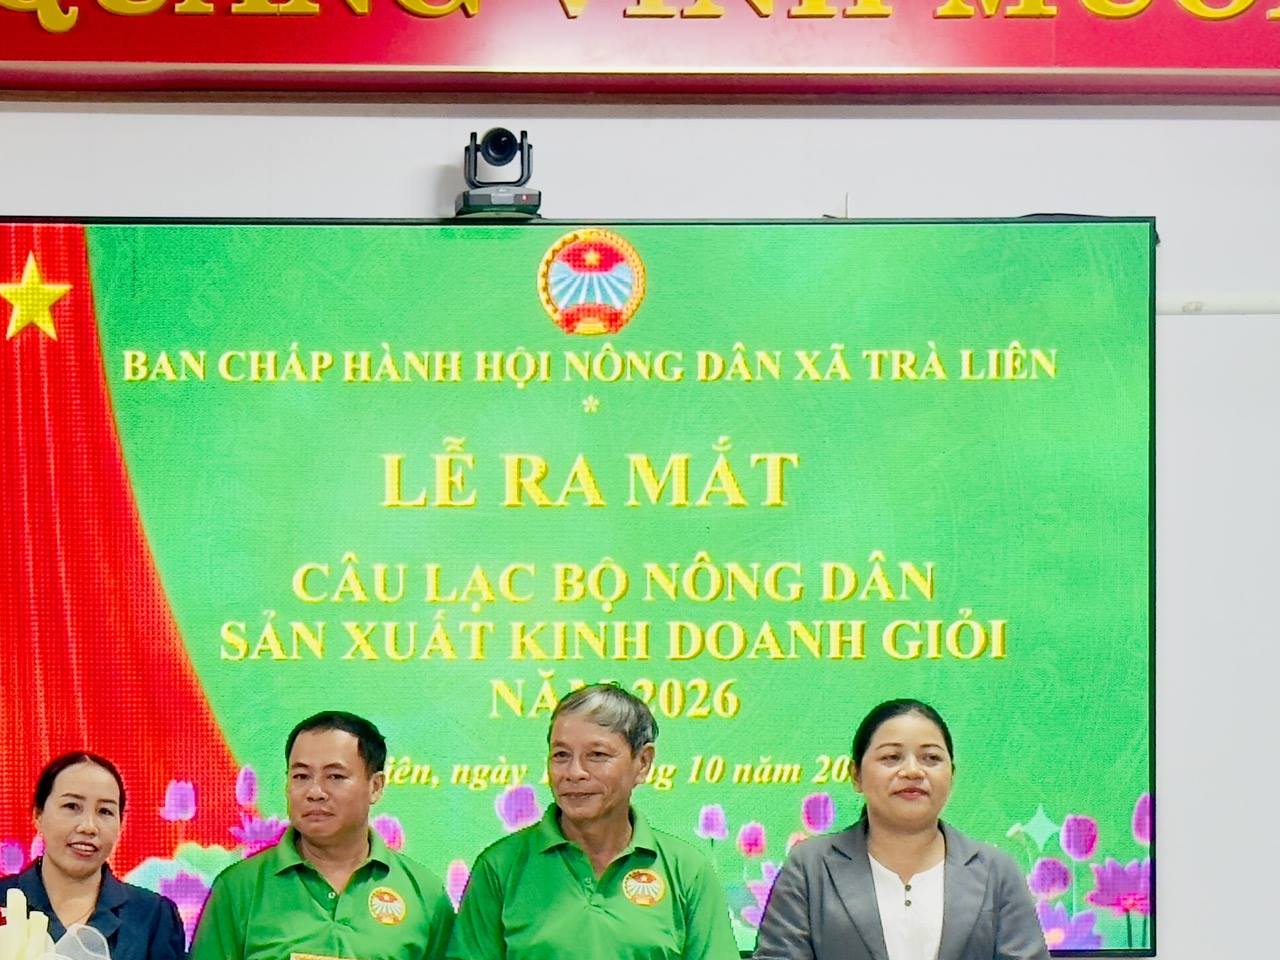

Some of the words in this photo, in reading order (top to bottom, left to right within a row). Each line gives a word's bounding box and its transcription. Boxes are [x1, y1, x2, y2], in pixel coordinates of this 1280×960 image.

[123, 350, 206, 382] BAN
[218, 342, 334, 383] CHẤP
[343, 342, 462, 383] HÀNH
[476, 346, 551, 389] HỘI
[564, 342, 684, 382] NÔNG
[696, 342, 781, 382] DÂN
[794, 343, 852, 381] XÃ
[863, 341, 947, 381] TRÀ
[960, 340, 1057, 380] LIÊN
[381, 436, 477, 508] LỄ
[501, 452, 607, 508] RA
[625, 435, 799, 508] MẮT
[291, 551, 407, 604] CÂU
[424, 562, 537, 614] LẠC
[552, 555, 629, 613] BỘ
[642, 550, 804, 602] NÔNG
[821, 549, 935, 602] DÂN
[219, 608, 326, 661] SẢN
[341, 608, 496, 661] XUẤT
[510, 620, 650, 661] KINH
[667, 619, 867, 661] DOANH
[881, 607, 1008, 661] GIỎI
[489, 668, 613, 718] NĂ
[631, 677, 742, 718] 2026
[451, 755, 529, 792] ngày
[688, 755, 726, 784] 10
[732, 755, 802, 784] năm
